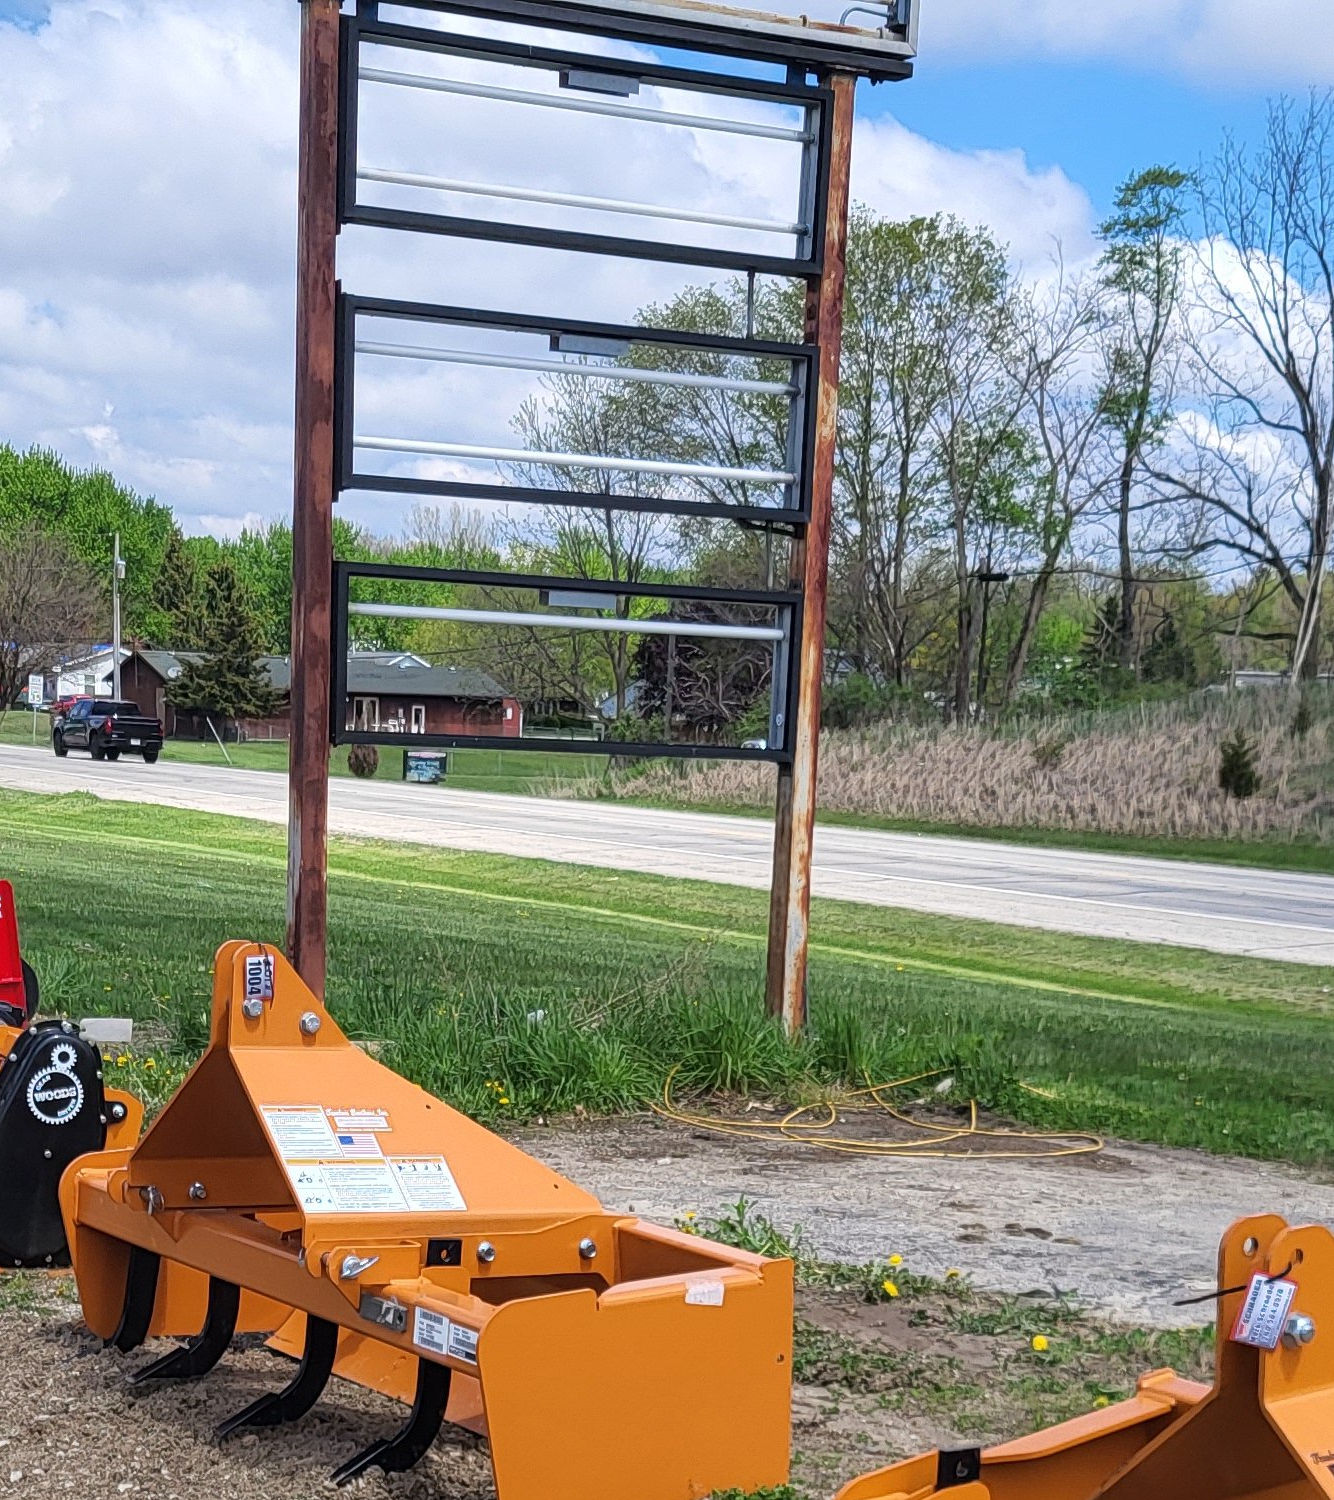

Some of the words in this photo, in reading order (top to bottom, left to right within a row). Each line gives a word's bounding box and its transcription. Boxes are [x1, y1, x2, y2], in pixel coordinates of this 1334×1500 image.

[248, 959, 262, 996] 1004
[33, 1085, 77, 1103] WOODS
[1243, 1280, 1263, 1324] SCHRADER
